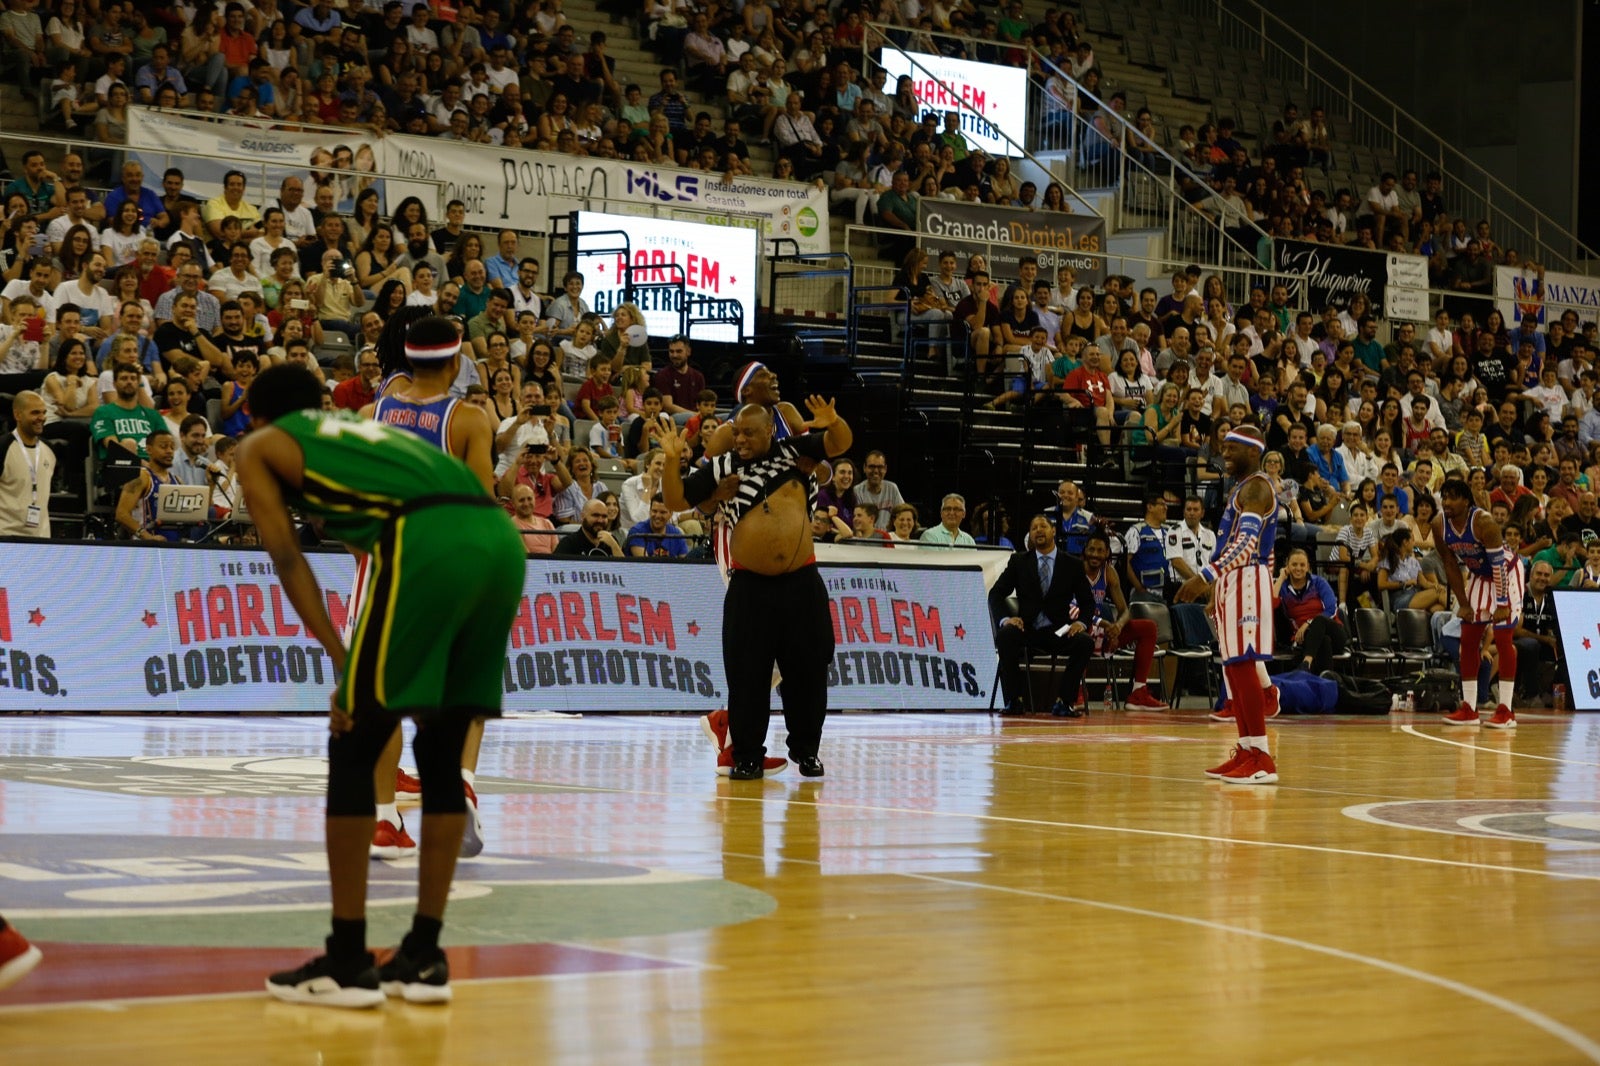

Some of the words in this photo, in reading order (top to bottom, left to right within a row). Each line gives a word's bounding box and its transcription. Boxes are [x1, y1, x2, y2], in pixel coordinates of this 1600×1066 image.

[911, 79, 985, 115] HARLEM
[240, 139, 296, 154] SANDERS
[400, 150, 436, 179] MODA
[499, 157, 608, 219] PORTAGO
[704, 179, 766, 196] Instalaciones
[768, 188, 785, 198] con
[787, 188, 809, 199] total
[660, 236, 694, 249] ORIGINAL
[616, 249, 720, 294] HARLEM
[1547, 283, 1600, 307] MANZA
[114, 418, 152, 435] CELTICS
[382, 408, 418, 428] LIGHTS
[418, 411, 440, 433] OUT
[219, 562, 243, 576] THE
[545, 571, 565, 584] THE
[571, 570, 626, 588] ORIGINAL
[828, 577, 846, 591] THE
[850, 577, 899, 593] ORIGINAL
[511, 590, 676, 651] HARLEM
[828, 596, 945, 653] ARLEM
